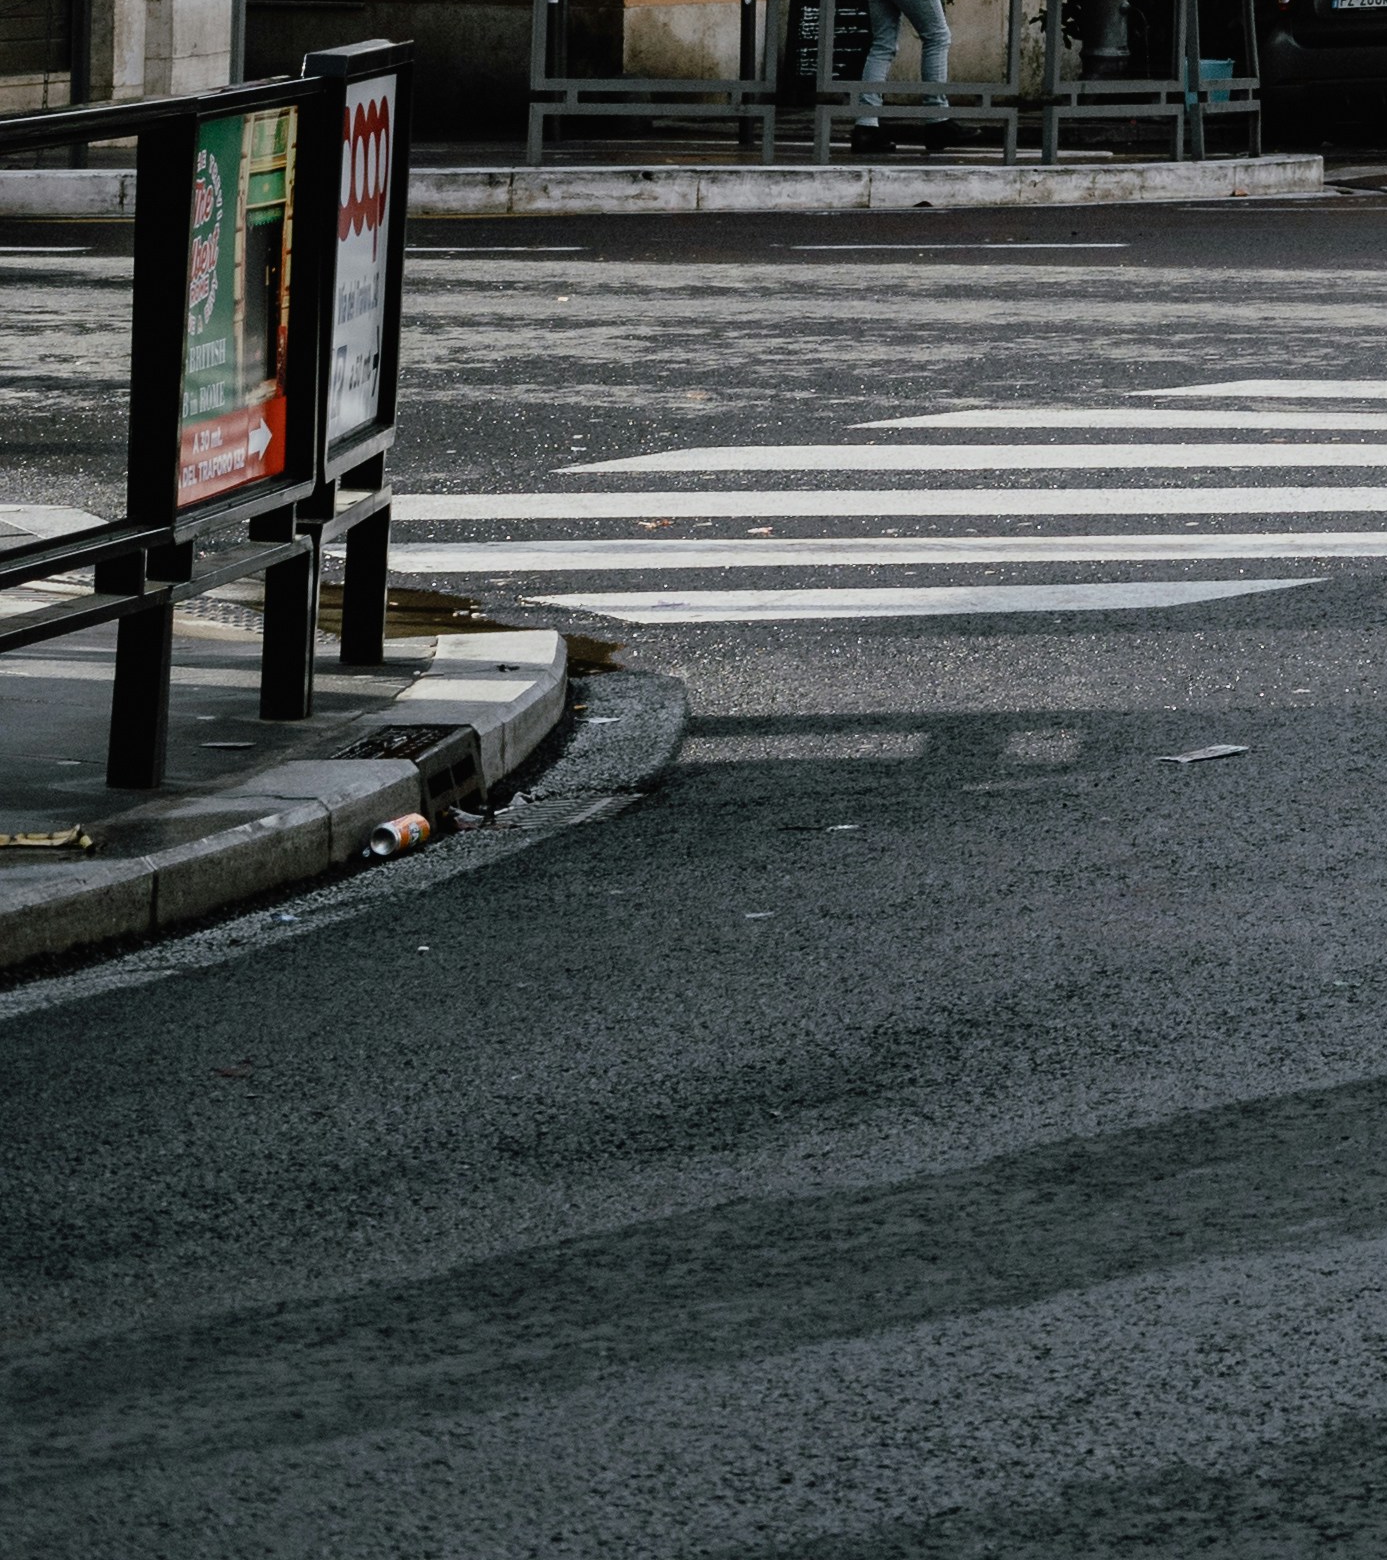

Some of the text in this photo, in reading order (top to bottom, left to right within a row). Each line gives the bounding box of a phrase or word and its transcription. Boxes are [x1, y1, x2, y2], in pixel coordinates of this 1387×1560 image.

[189, 338, 227, 375] BRITISH
[199, 381, 226, 413] ROME
[192, 433, 199, 455] A
[200, 429, 210, 452] 30
[182, 465, 198, 489] DEL
[198, 452, 233, 483] TRAFORO
